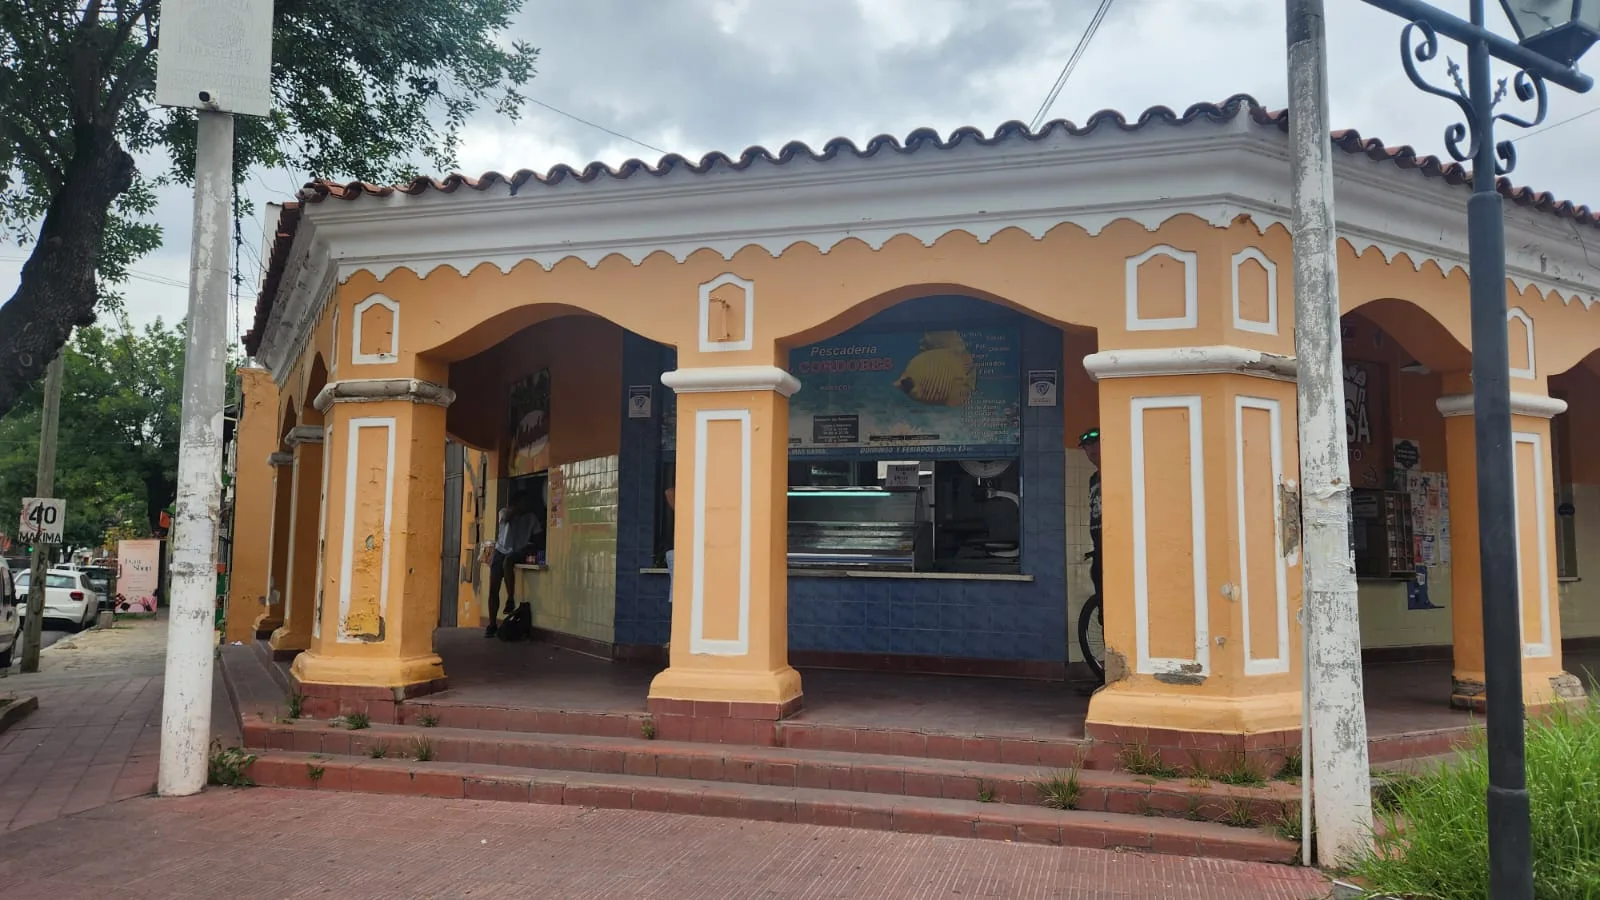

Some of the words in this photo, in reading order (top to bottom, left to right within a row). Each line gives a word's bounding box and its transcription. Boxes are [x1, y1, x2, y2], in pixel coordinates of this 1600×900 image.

[1344, 399, 1371, 444] SA
[1347, 448, 1362, 461] TO
[29, 506, 57, 524] 40
